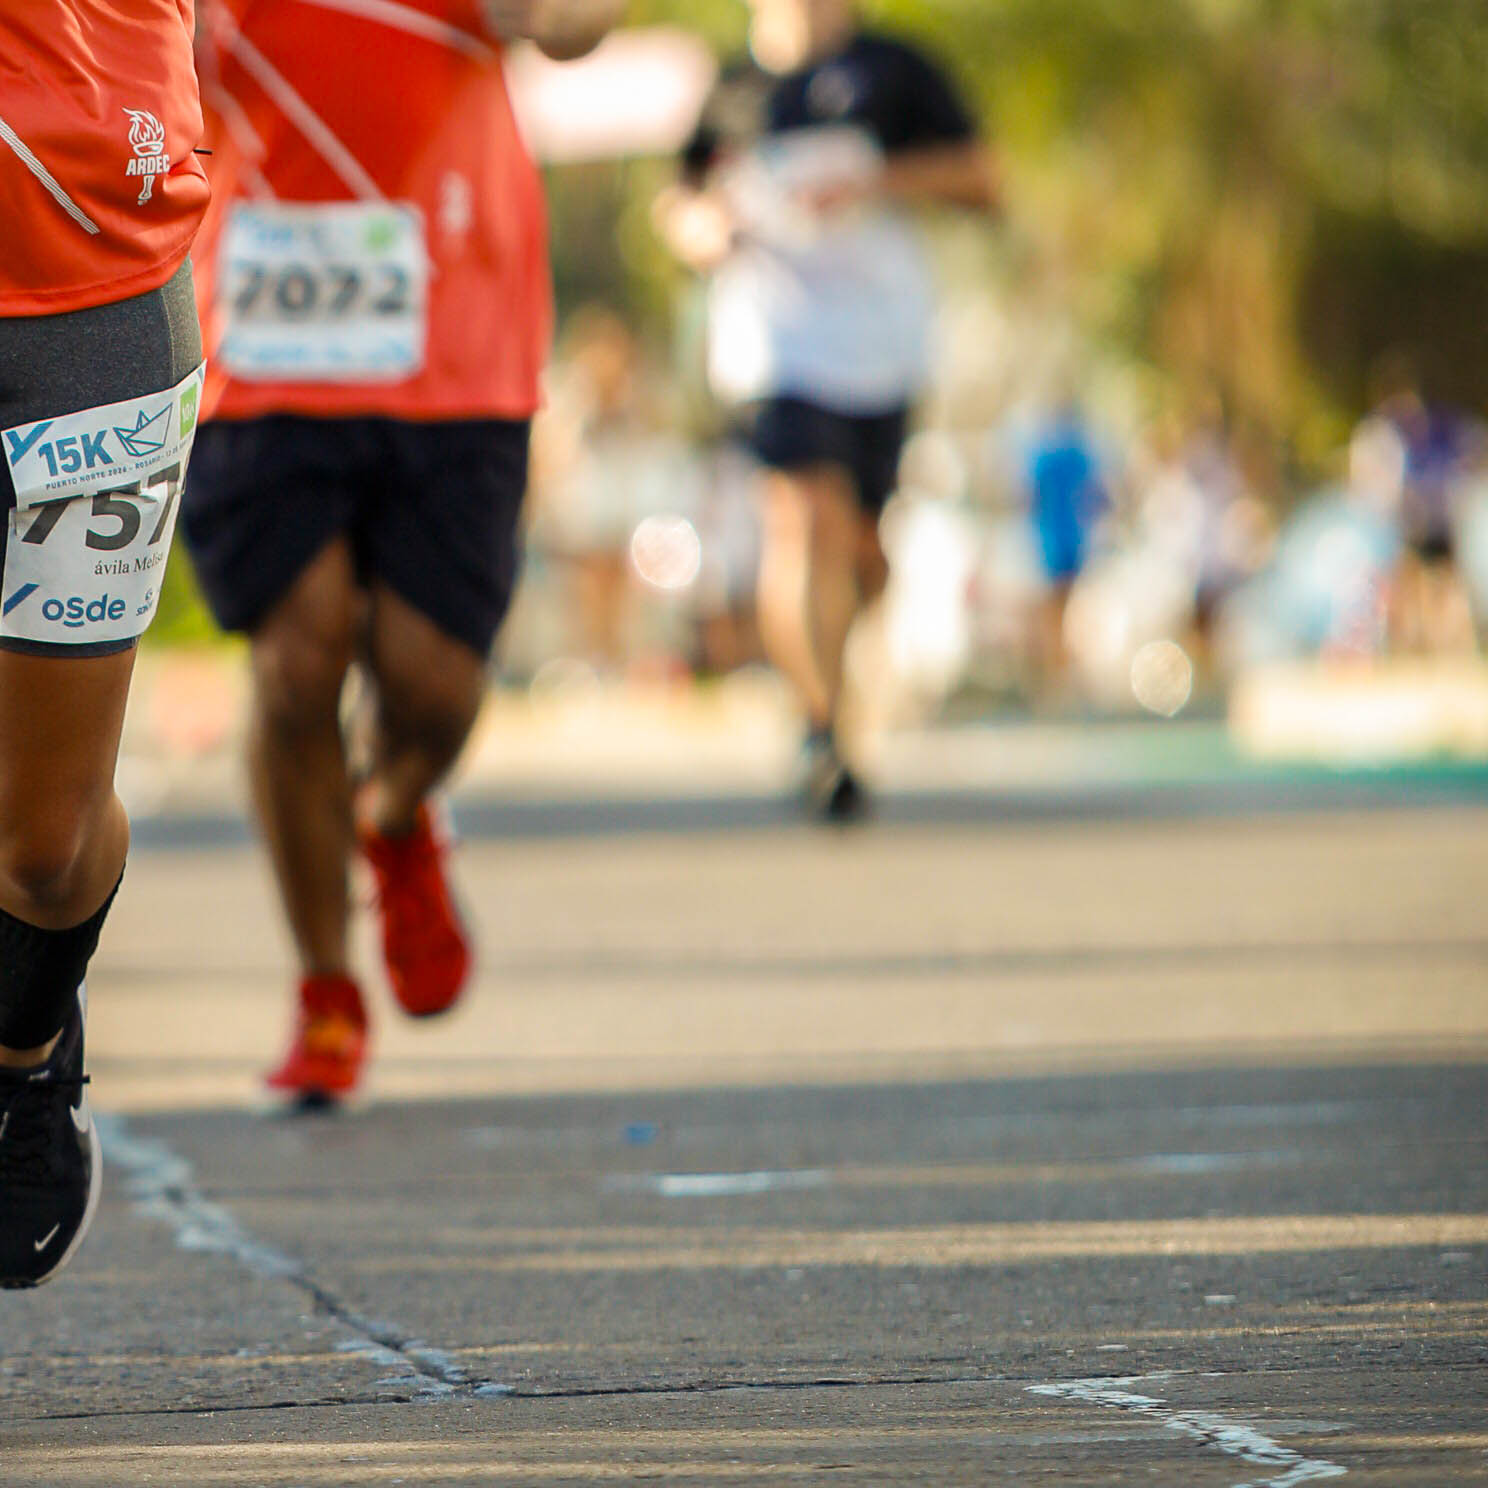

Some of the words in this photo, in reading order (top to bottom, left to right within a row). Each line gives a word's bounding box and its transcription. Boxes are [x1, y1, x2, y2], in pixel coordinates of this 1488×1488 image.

[125, 153, 171, 177] ARDEC
[233, 262, 409, 322] 7072
[37, 429, 114, 477] 15K
[45, 477, 78, 490] PUERTO
[79, 471, 106, 483] NORTE
[41, 592, 126, 625] osde
